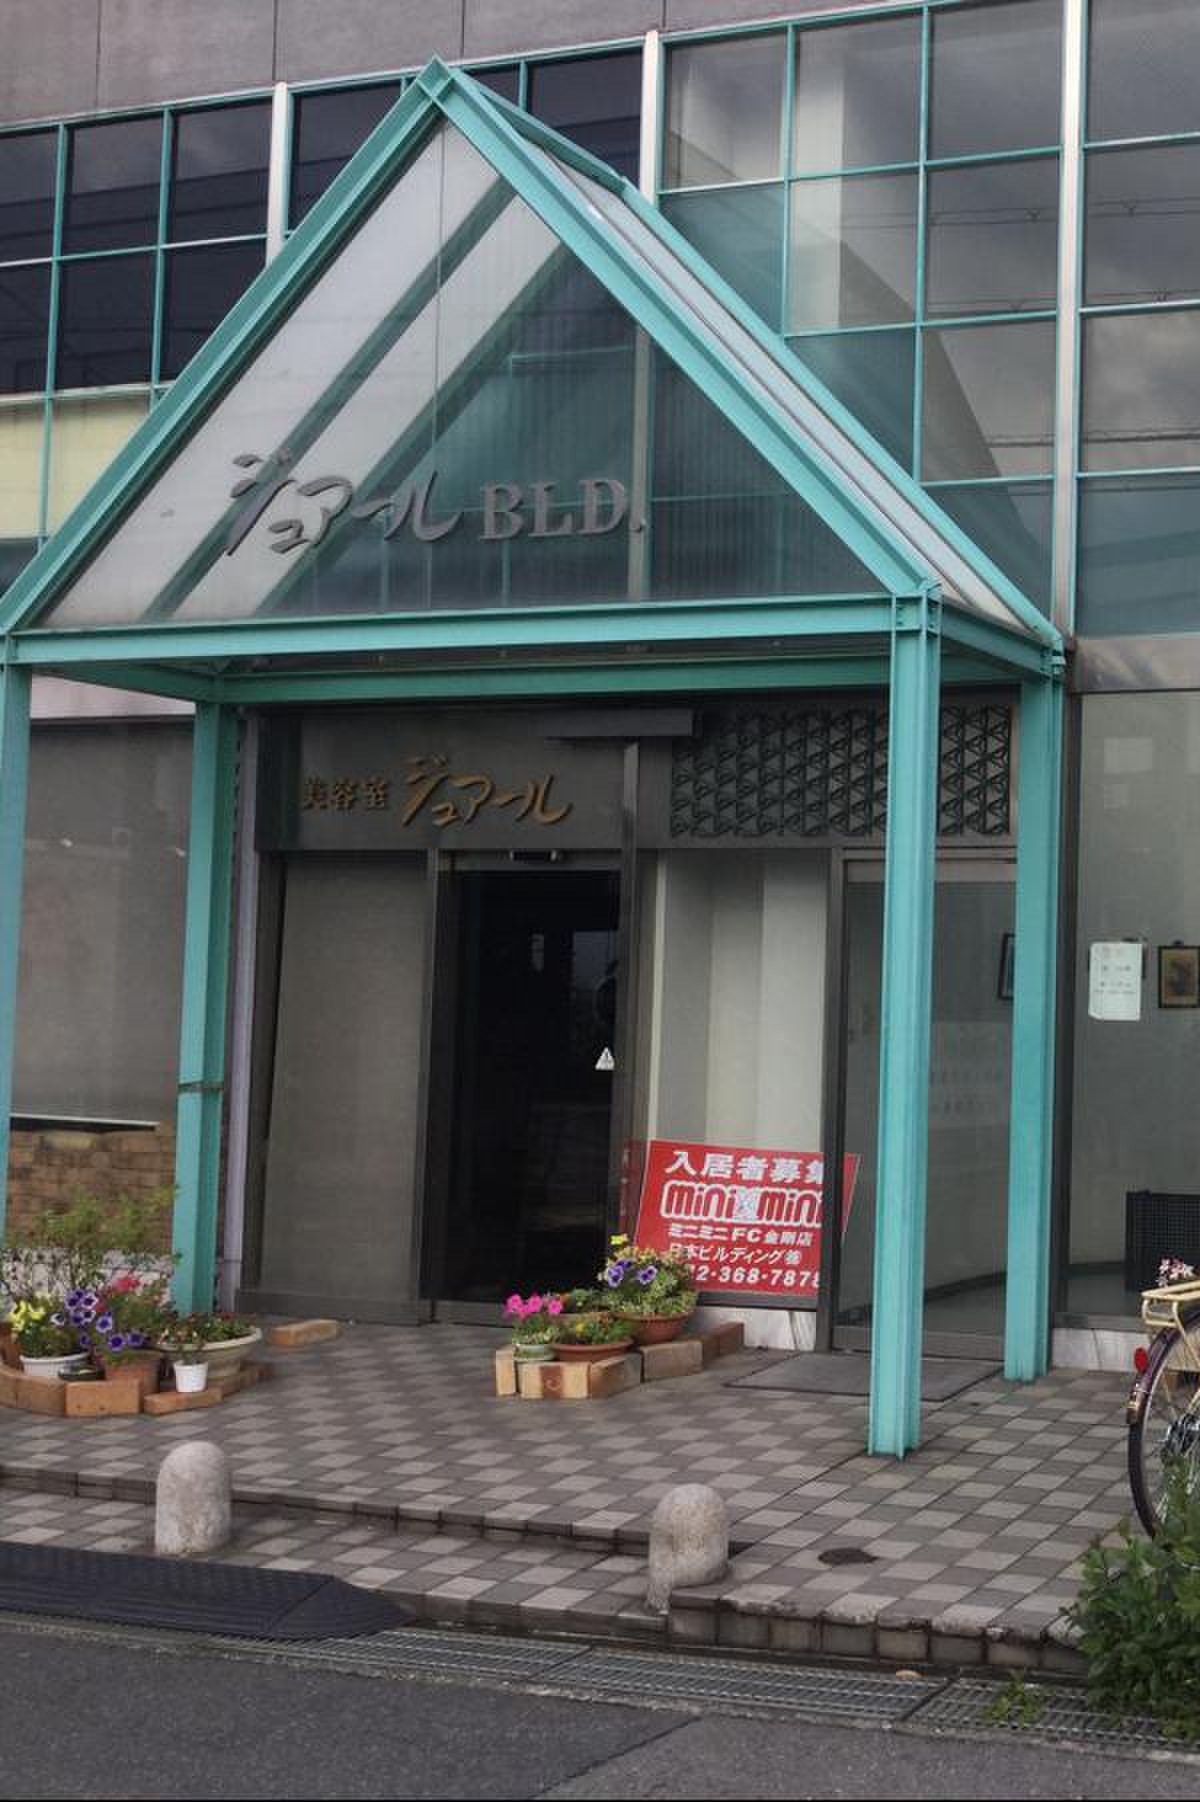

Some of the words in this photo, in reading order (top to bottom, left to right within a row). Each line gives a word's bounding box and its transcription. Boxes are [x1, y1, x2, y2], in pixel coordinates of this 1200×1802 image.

[227, 453, 462, 556] ジュアール
[400, 753, 573, 828] ジュアール
